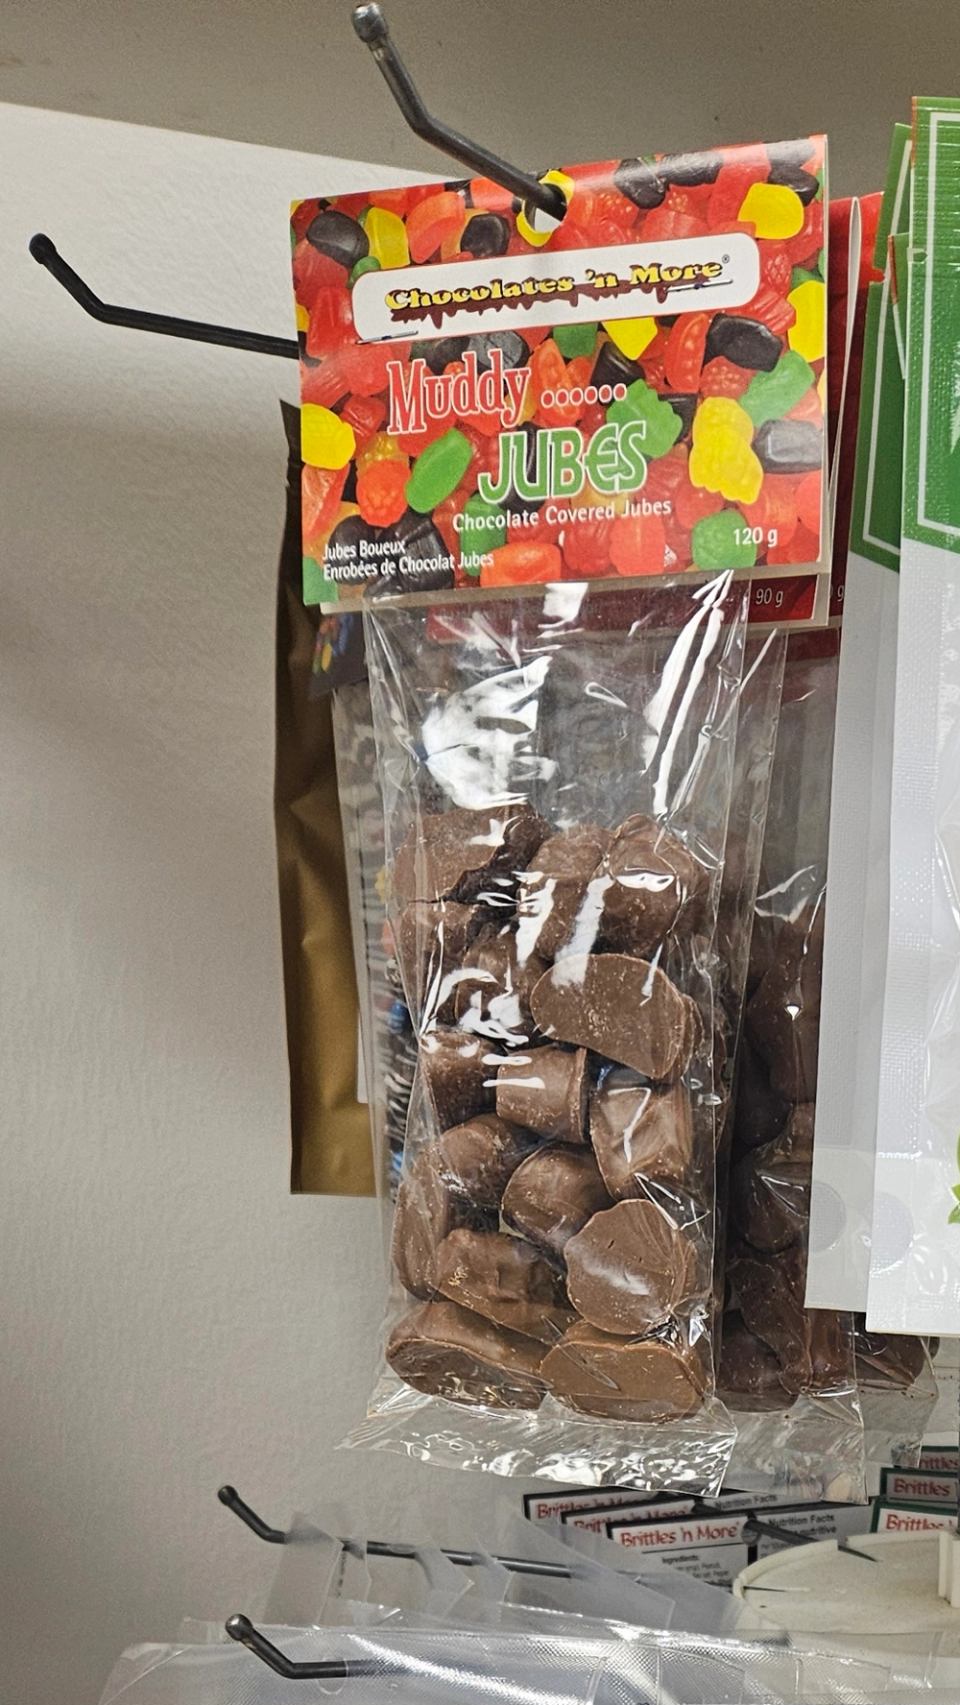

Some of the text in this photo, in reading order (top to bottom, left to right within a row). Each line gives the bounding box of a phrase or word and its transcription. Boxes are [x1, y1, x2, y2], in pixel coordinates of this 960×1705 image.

[385, 277, 574, 311] Chocolates
[630, 261, 723, 286] More
[386, 349, 531, 435] Muddy
[478, 420, 646, 504] JUBES
[452, 498, 672, 533] Chocolate Covered Jubes
[323, 538, 405, 562] Jubes Boueux
[732, 528, 778, 548] 120 g
[323, 551, 494, 582] Enrobées de Chocolat Jubes
[755, 587, 784, 608] 90 g
[893, 1479, 951, 1497] Brittles
[810, 1513, 835, 1524] Facts
[620, 1529, 677, 1548] Brittles
[697, 1524, 738, 1541] More
